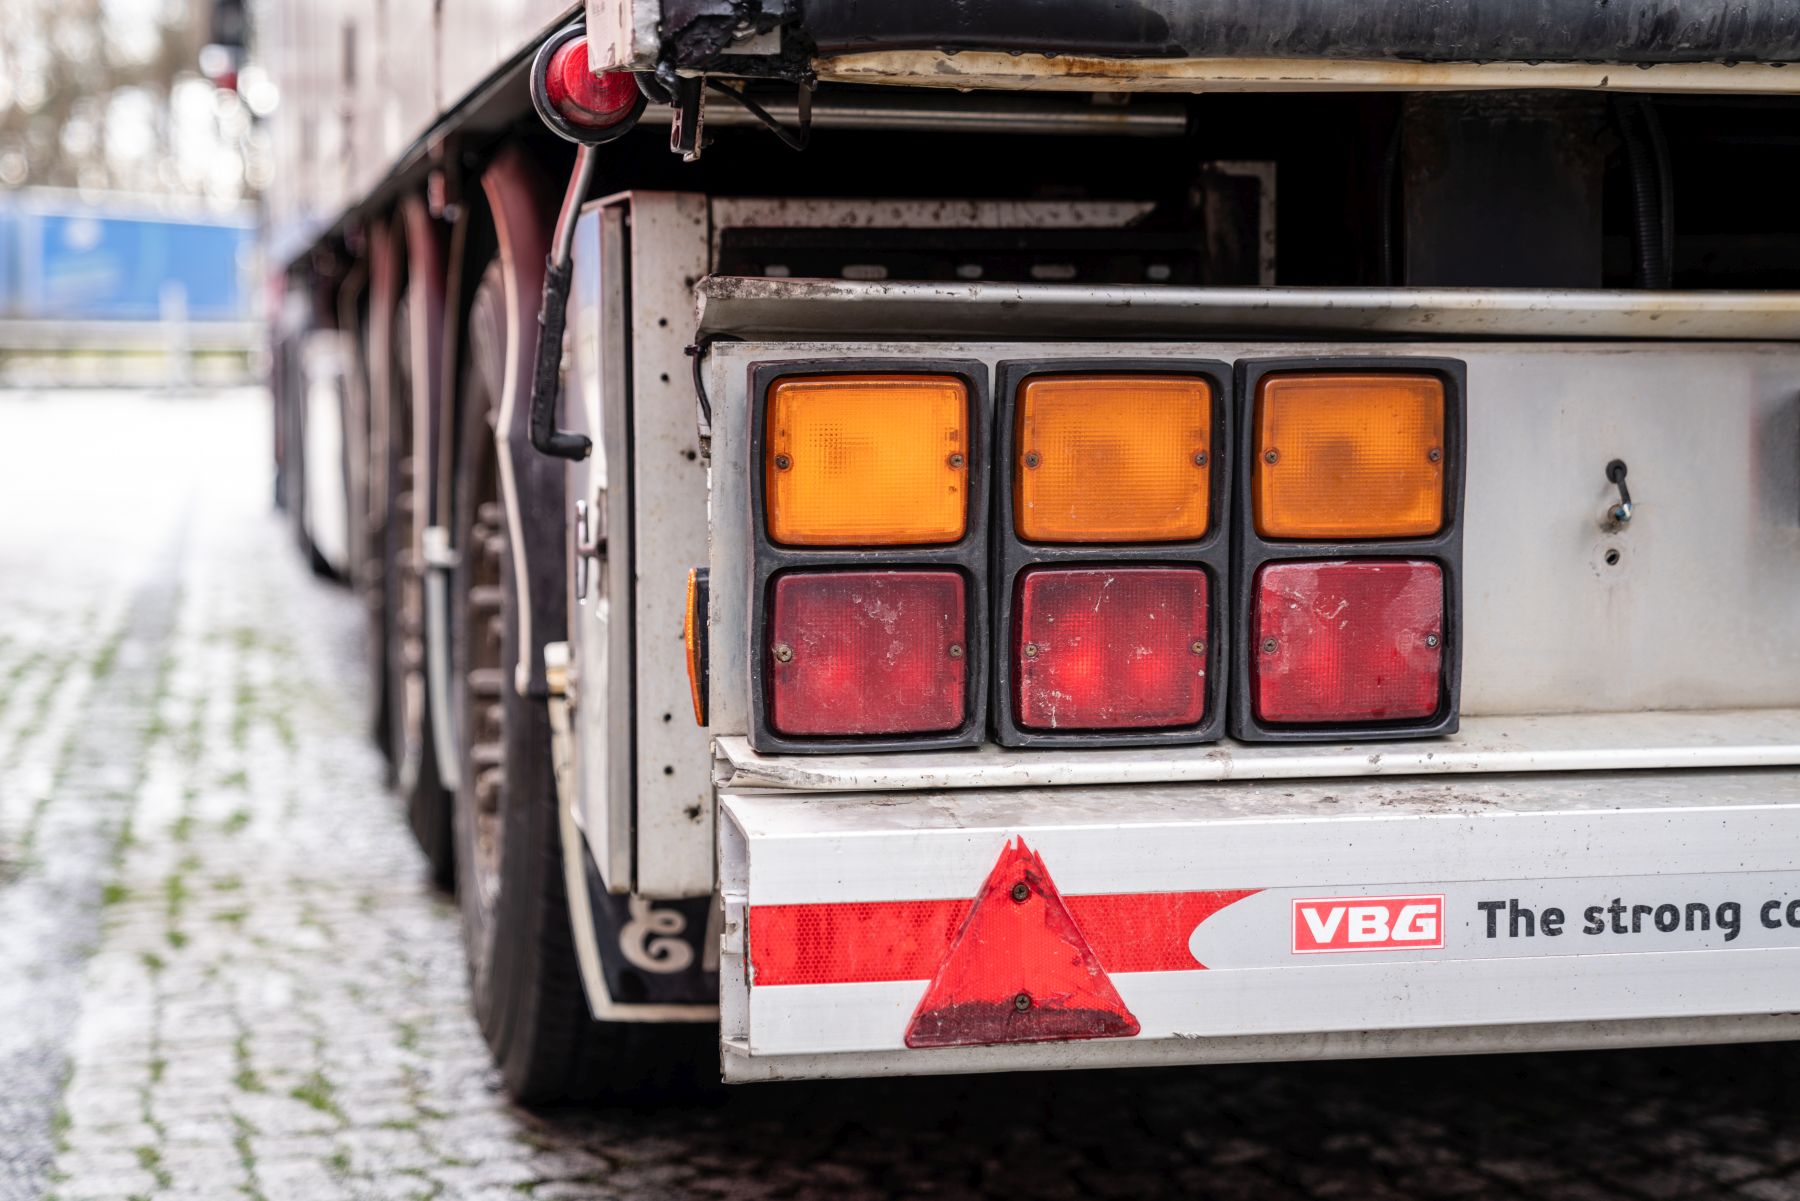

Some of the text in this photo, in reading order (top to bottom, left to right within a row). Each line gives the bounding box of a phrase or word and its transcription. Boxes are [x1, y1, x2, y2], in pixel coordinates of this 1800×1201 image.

[1301, 904, 1437, 943] VBG
[1477, 898, 1566, 939] The
[1582, 897, 1741, 942] strong
